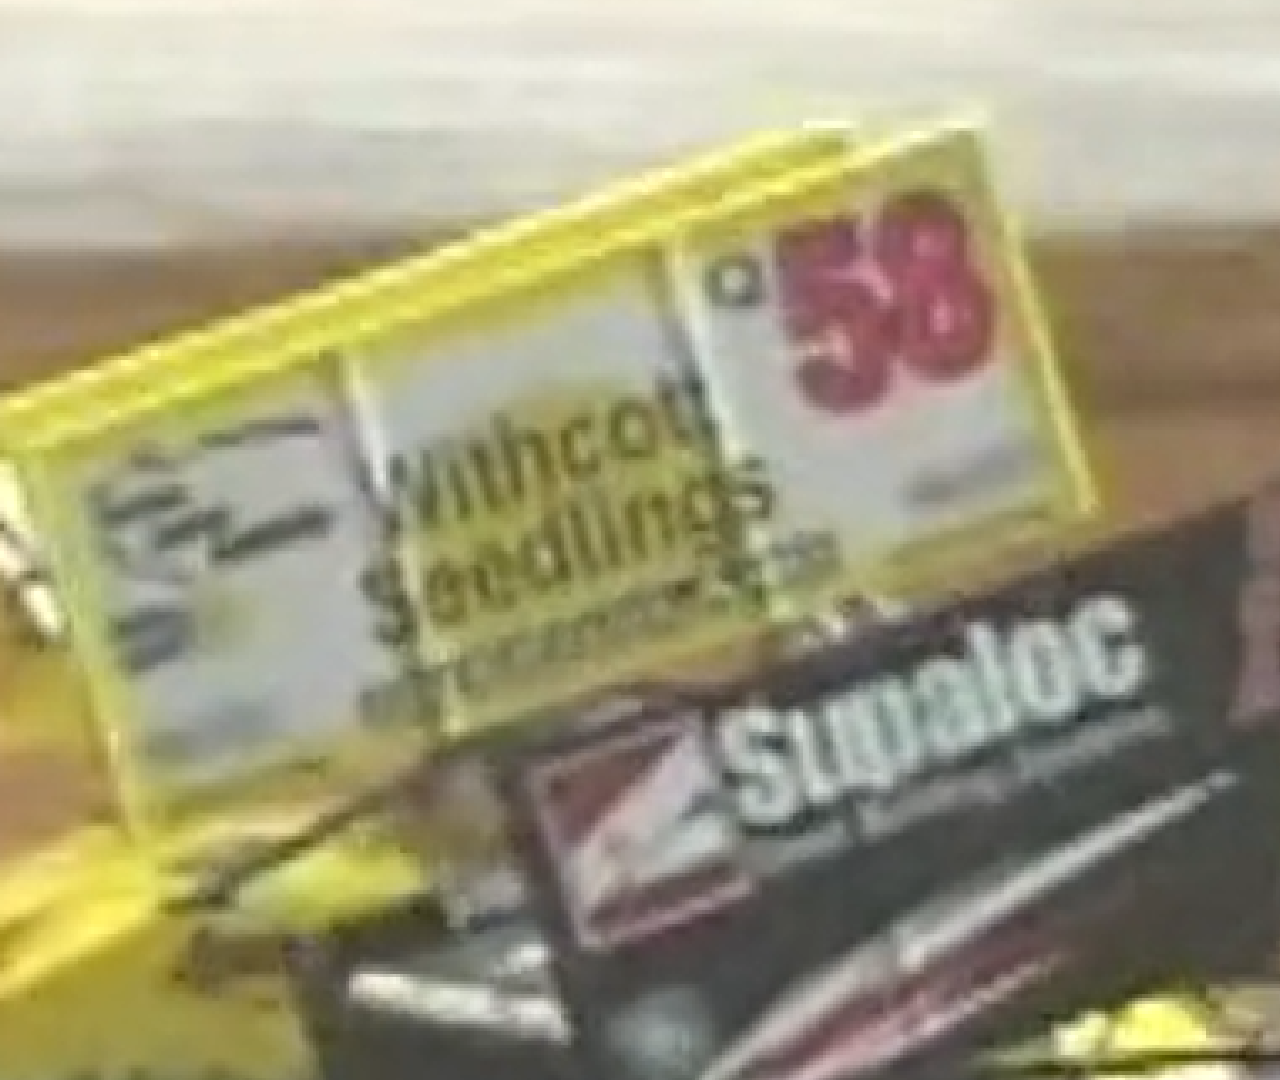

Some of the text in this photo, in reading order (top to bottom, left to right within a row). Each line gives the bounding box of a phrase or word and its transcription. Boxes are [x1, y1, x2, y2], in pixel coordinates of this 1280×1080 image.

[775, 190, 998, 415] 58
[356, 452, 776, 648] Seedlings
[718, 596, 1148, 824] Supaloc
